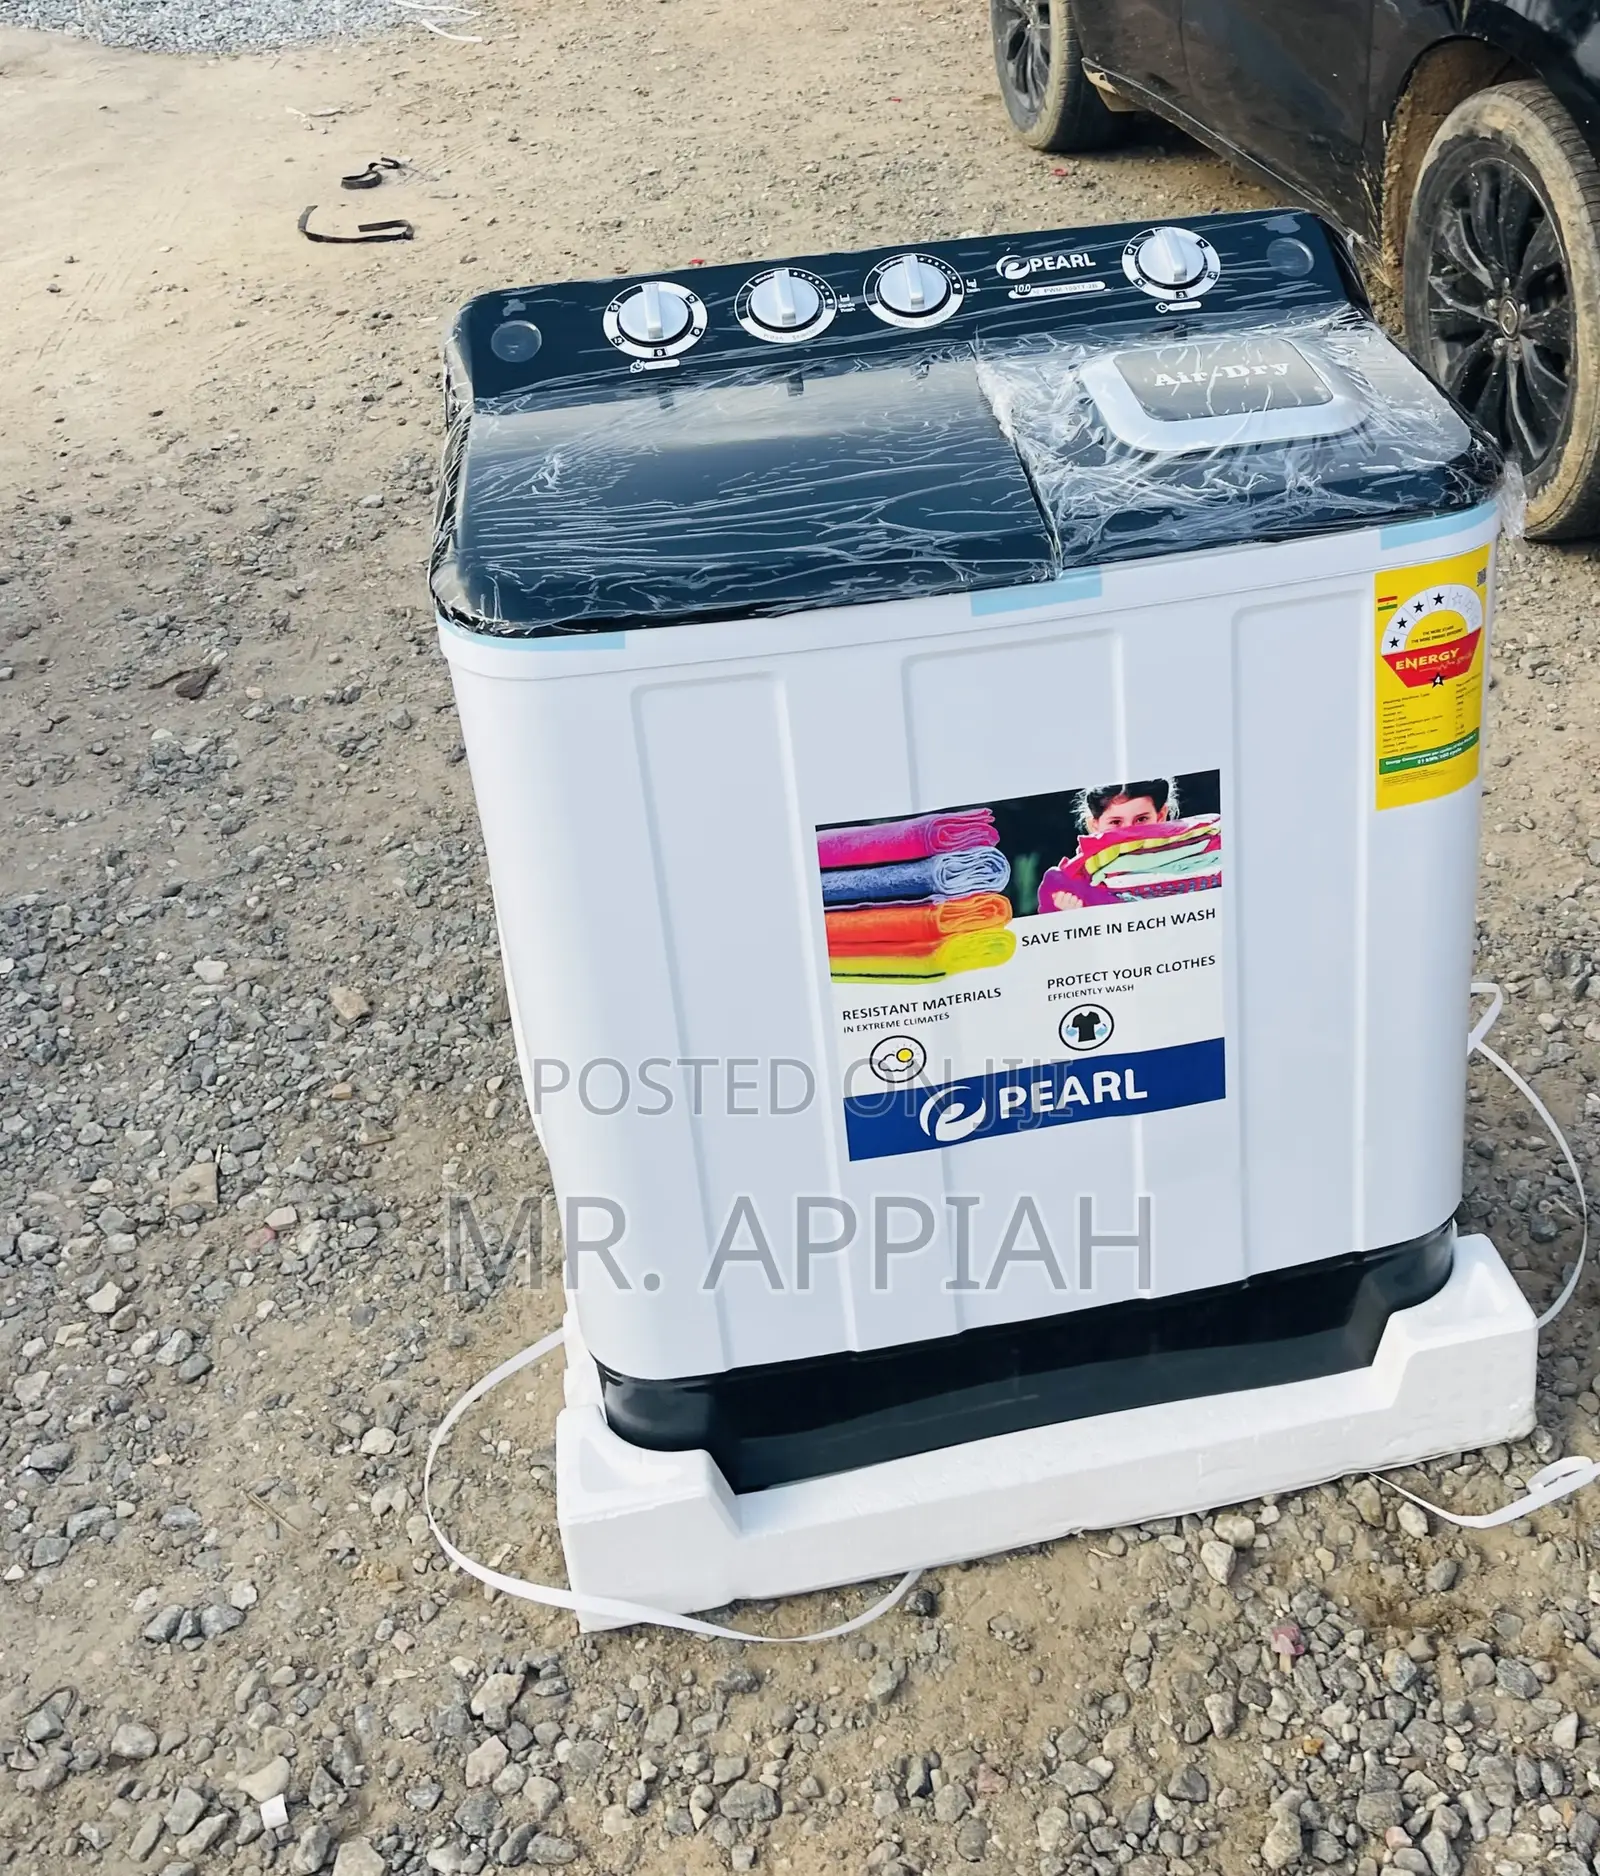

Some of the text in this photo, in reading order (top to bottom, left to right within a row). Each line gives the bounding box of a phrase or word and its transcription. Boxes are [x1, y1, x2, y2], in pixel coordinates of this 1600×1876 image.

[1030, 253, 1096, 272] PEARL
[1395, 648, 1460, 671] ENERGY
[1021, 908, 1216, 947] SAVE TIME IN EACH WASH
[1047, 955, 1216, 989] PROTECT YOUR CLOTHES
[842, 987, 1002, 1020] RESISTANT MATERIALS
[1047, 984, 1135, 1001] EFFICIENTLY WASH
[843, 1012, 950, 1034] IN EXTREME CLIMATES
[998, 1069, 1148, 1119] PEARL
